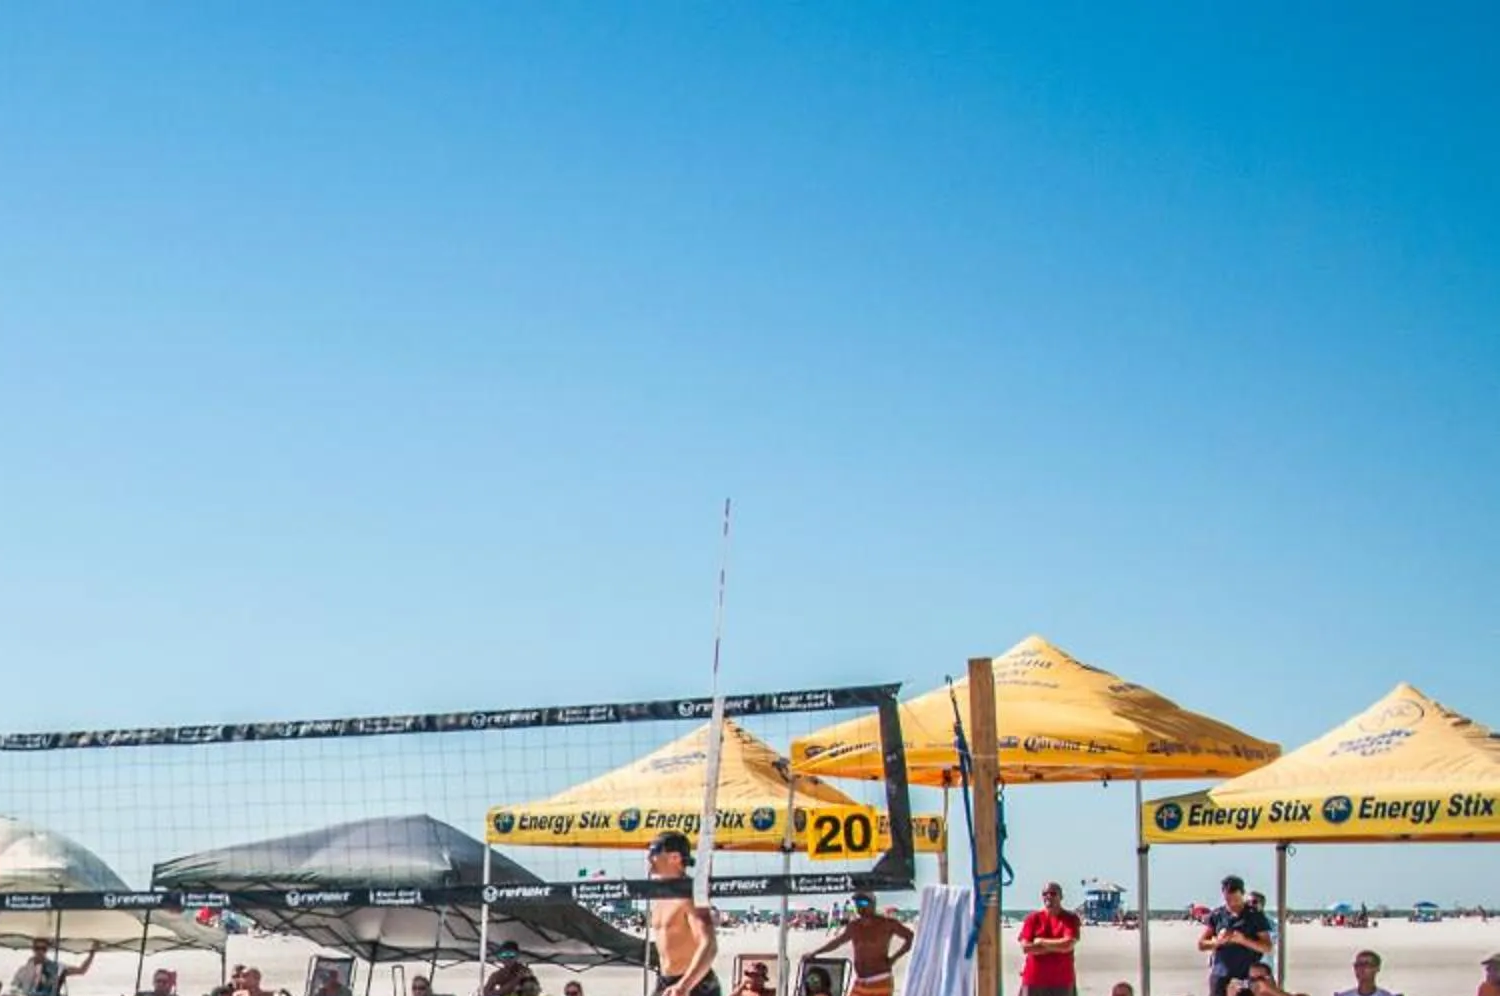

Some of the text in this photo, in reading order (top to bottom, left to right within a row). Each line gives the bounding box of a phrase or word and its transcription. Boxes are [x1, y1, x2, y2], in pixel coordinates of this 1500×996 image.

[518, 812, 574, 834] Energy
[578, 811, 611, 829] Stix
[644, 810, 701, 833] Energy
[1187, 793, 1494, 830] Energy Stix Energy Stix
[814, 814, 872, 854] 20
